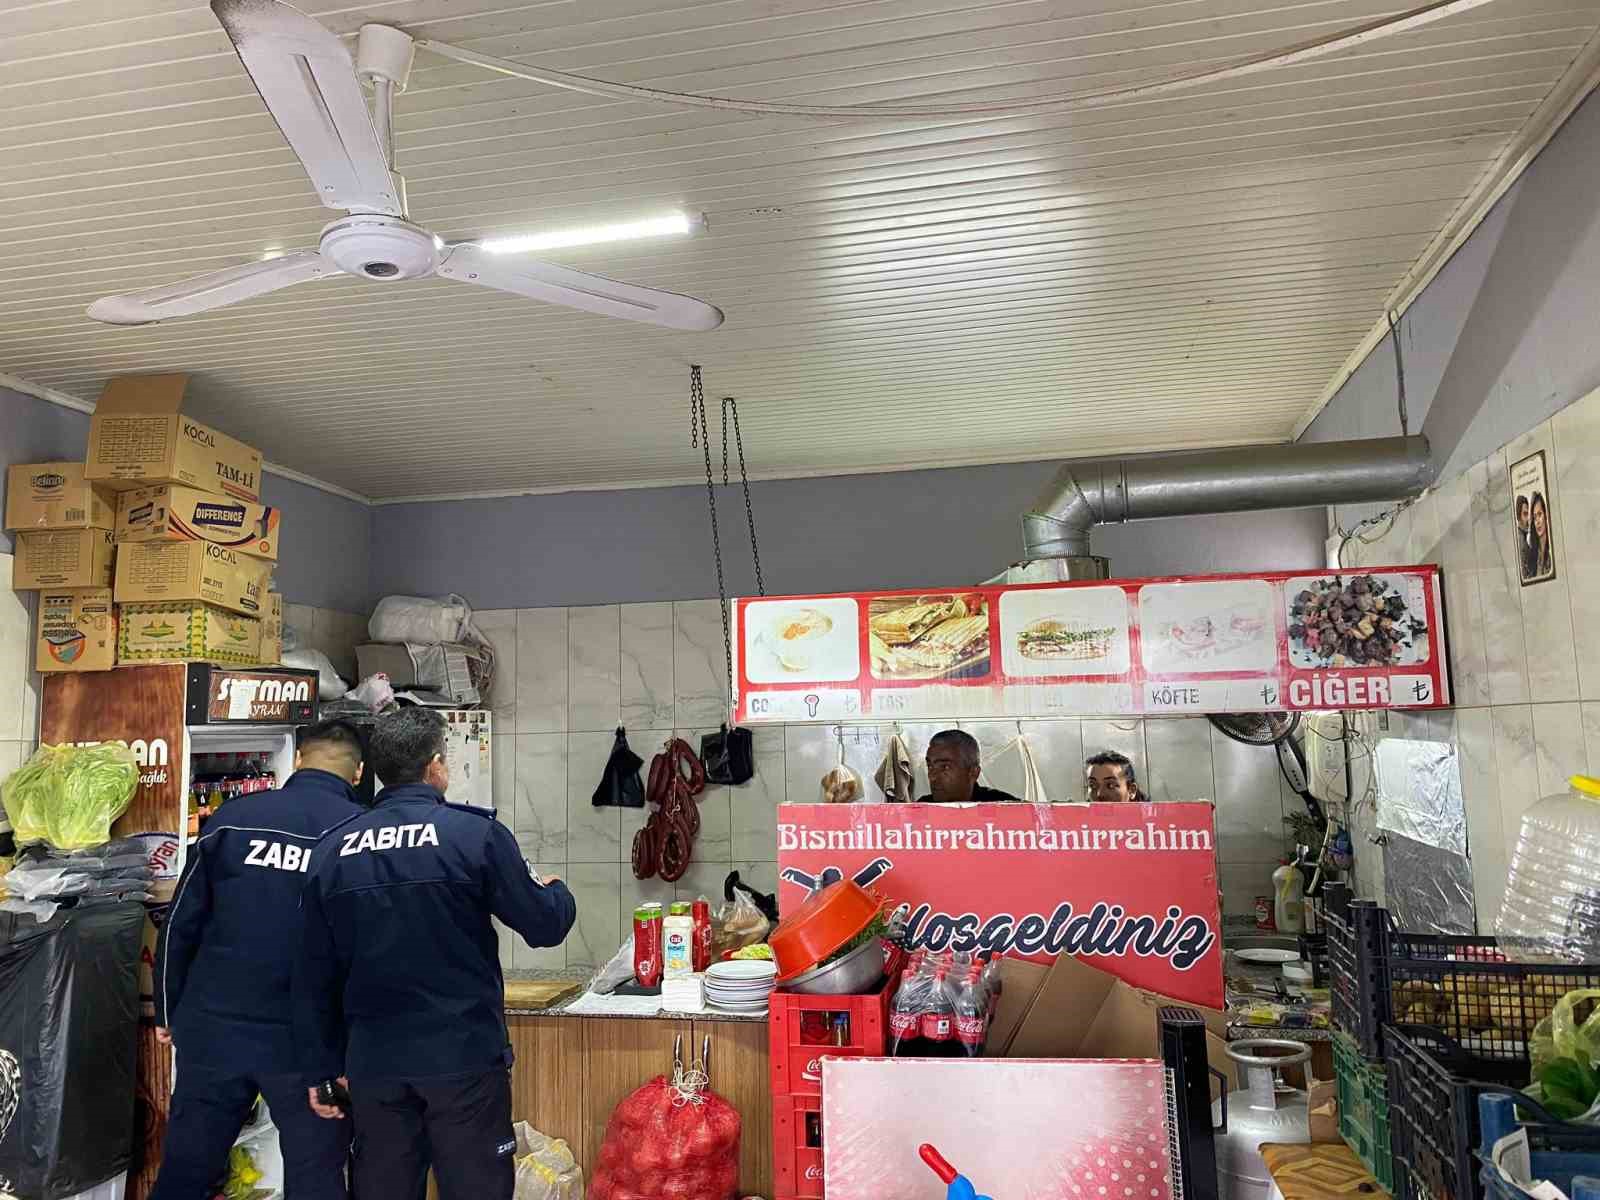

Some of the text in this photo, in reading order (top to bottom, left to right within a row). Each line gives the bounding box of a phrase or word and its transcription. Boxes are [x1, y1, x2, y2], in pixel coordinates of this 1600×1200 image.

[183, 423, 216, 448] KOCAL
[195, 507, 244, 522] DIFFERENCE
[206, 543, 237, 564] KOCAL
[217, 678, 309, 702] STMAN
[1151, 685, 1200, 705] KÖFTE
[1289, 672, 1391, 706] CİĞER
[339, 822, 440, 857] ZABITA
[148, 840, 179, 871] yran
[244, 840, 312, 873] ZABI
